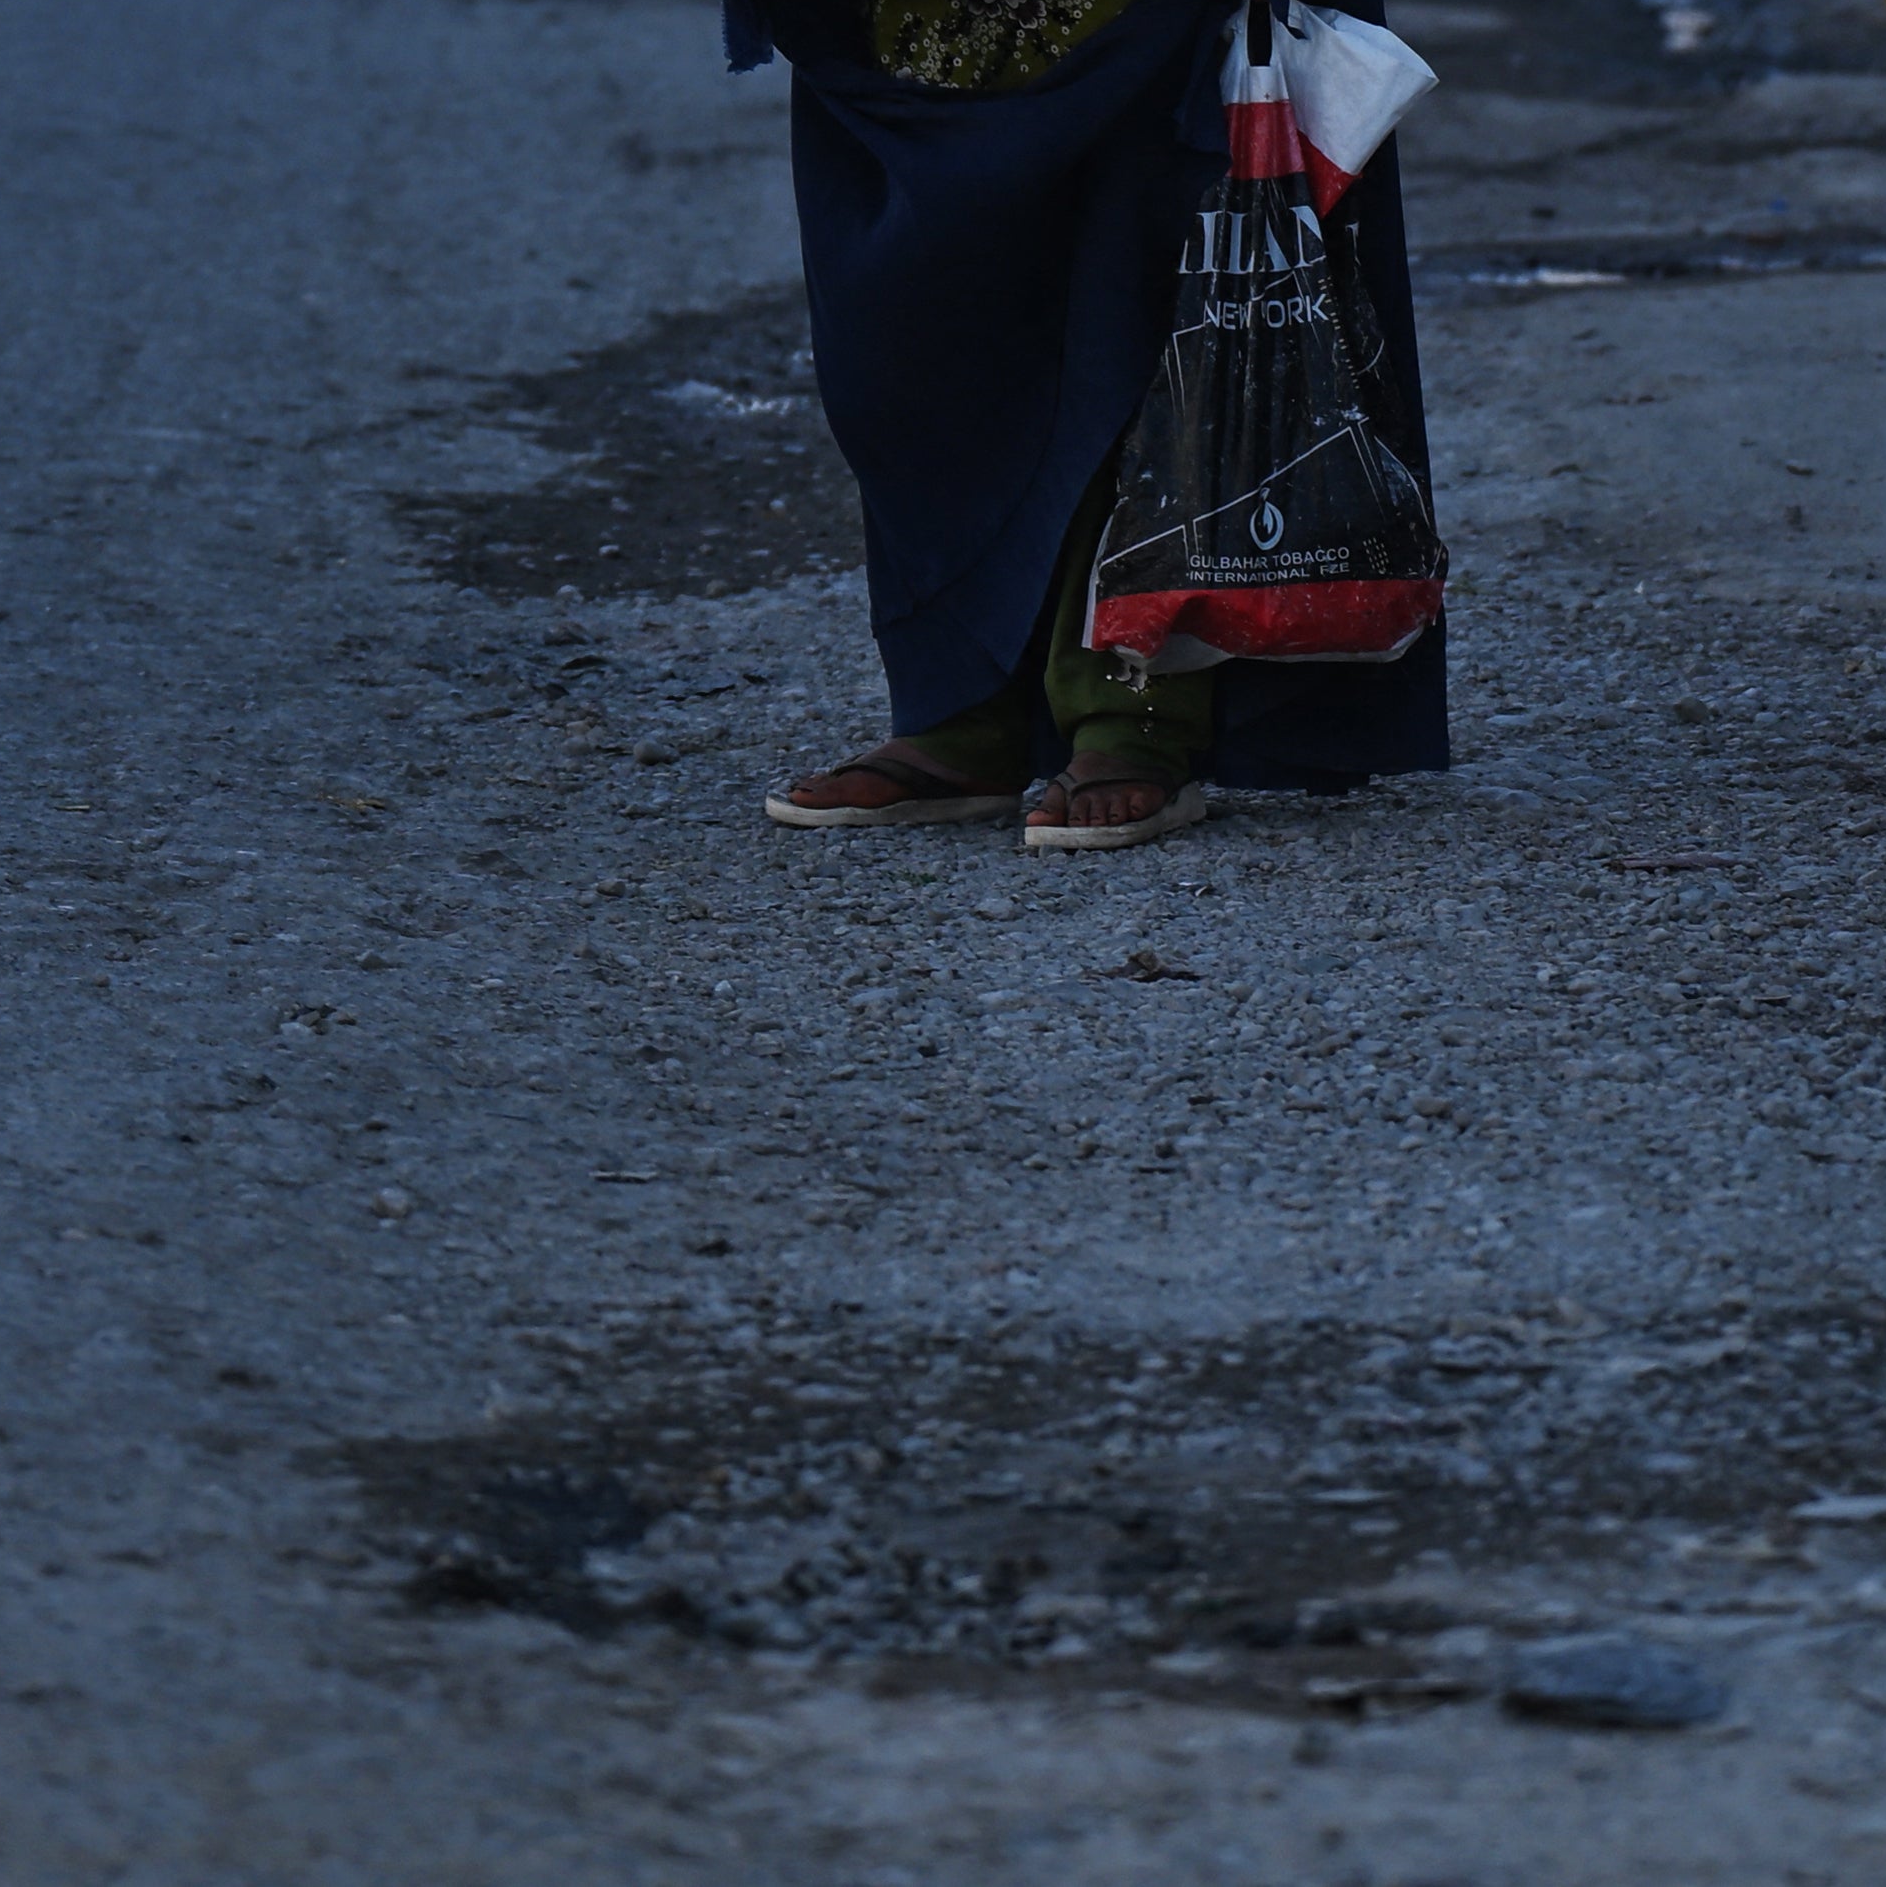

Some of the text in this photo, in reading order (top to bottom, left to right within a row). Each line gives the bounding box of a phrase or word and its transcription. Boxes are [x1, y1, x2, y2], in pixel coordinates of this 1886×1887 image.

[1204, 299, 1253, 331] NEW
[1189, 546, 1350, 571] GULBAHAR TOBACCO
[1189, 561, 1351, 584] INTERNATIONAL FZE
